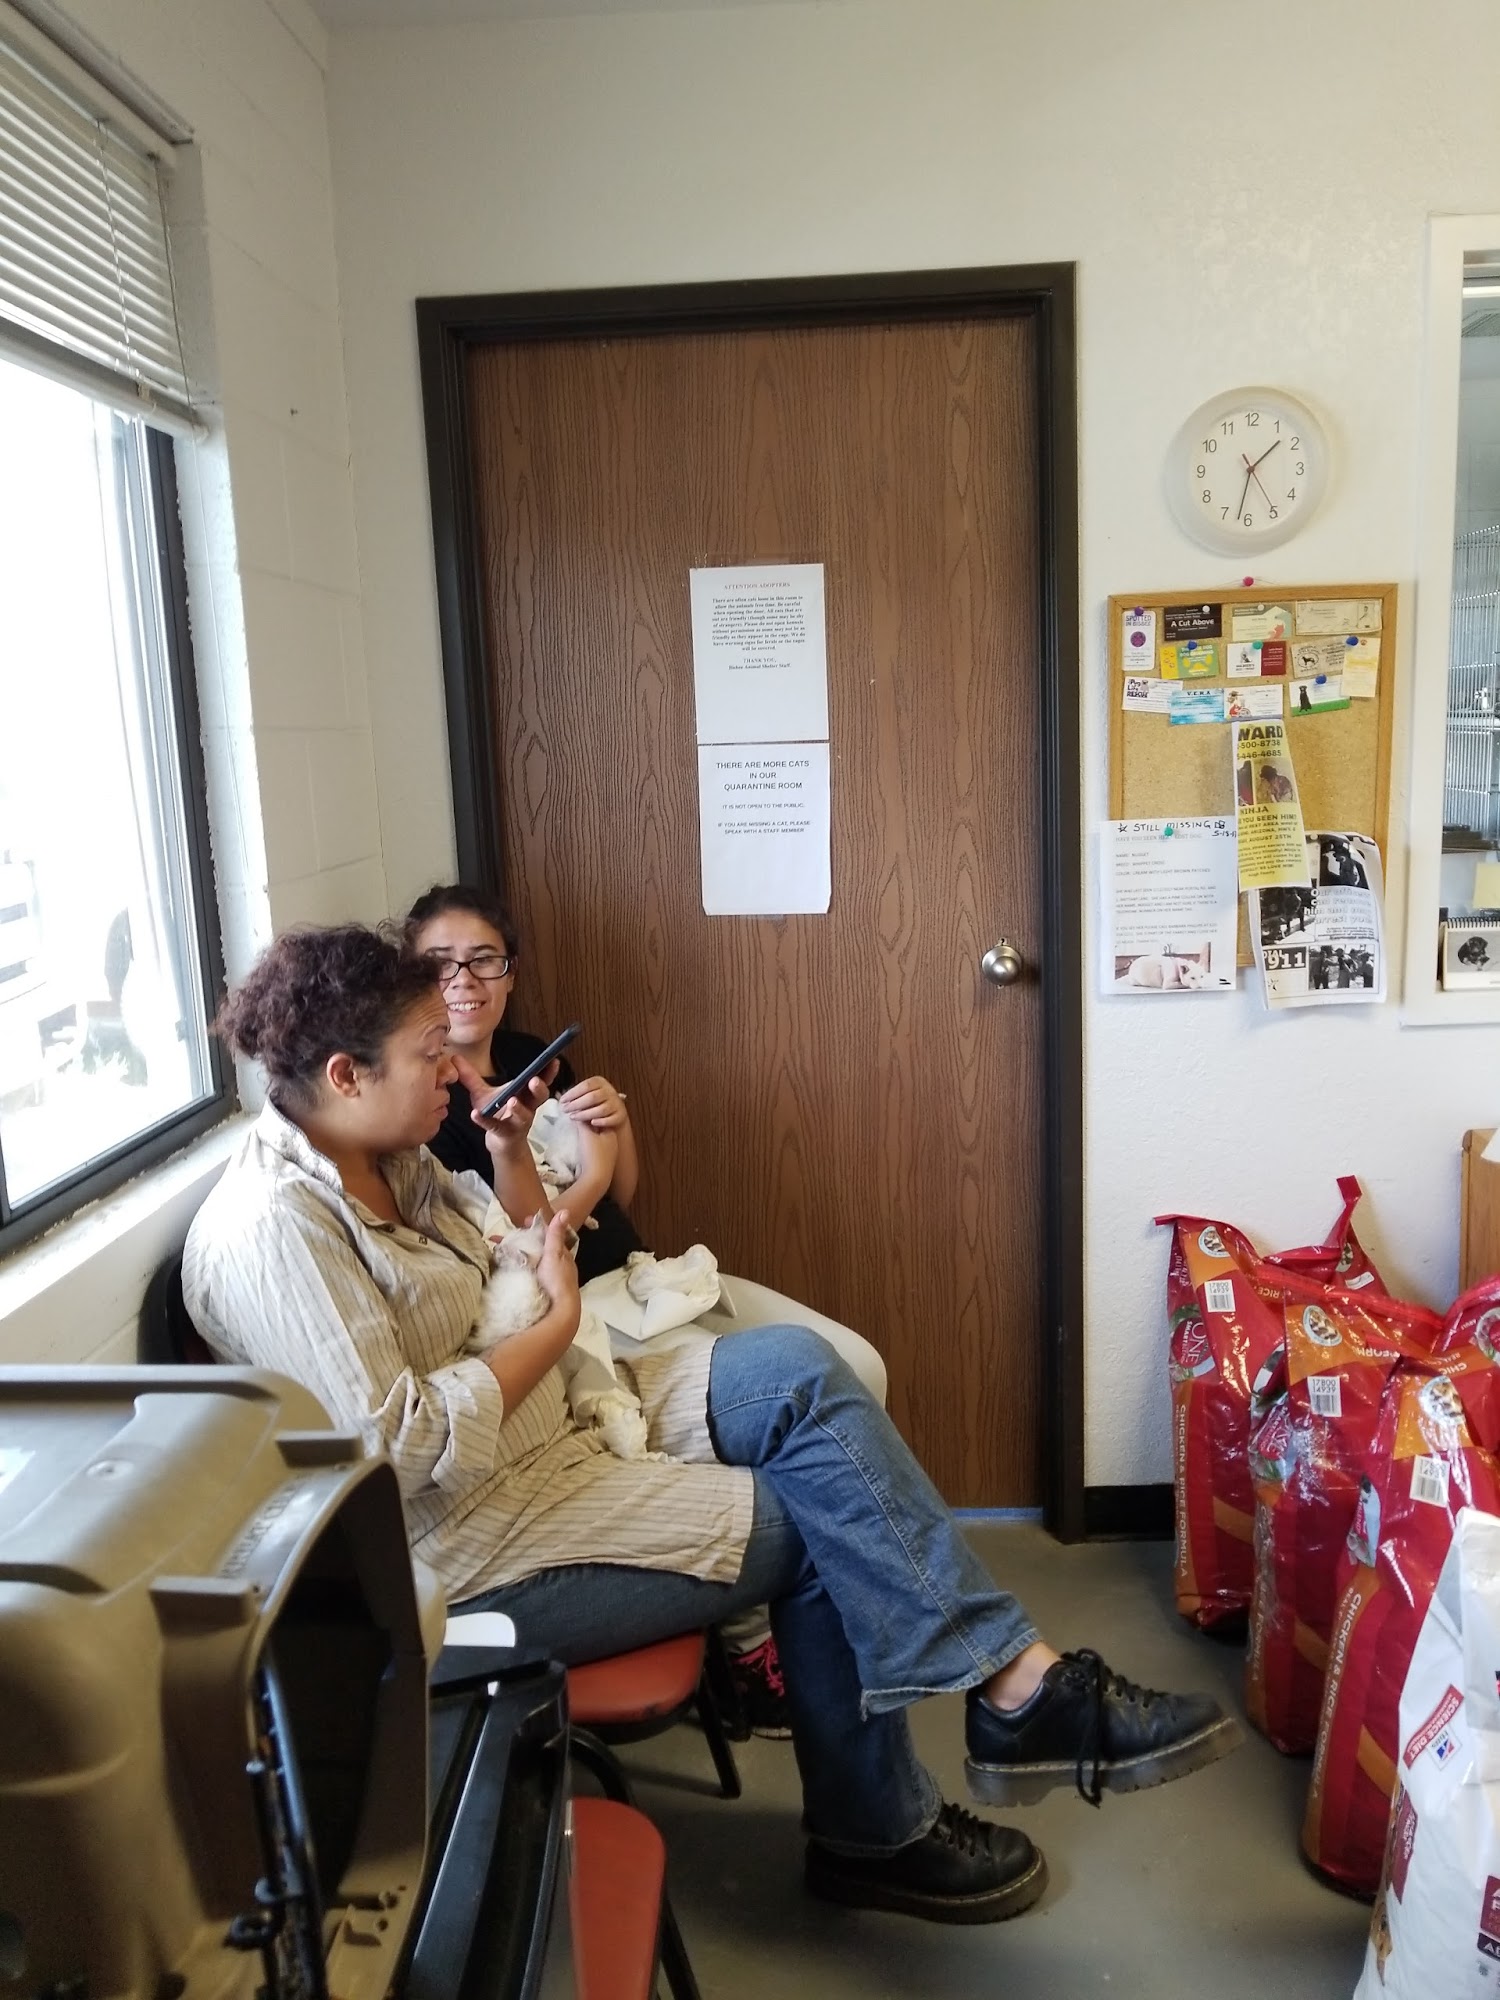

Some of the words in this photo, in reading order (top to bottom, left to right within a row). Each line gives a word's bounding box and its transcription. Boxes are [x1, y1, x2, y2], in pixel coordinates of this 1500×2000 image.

[1245, 413, 1259, 426] 12
[1221, 422, 1234, 435] 11
[1274, 420, 1280, 433] 1
[1202, 439, 1217, 453] 10
[1290, 437, 1300, 450] 2
[1196, 465, 1205, 478] 9
[1295, 462, 1304, 475] 3
[1202, 490, 1211, 503] 8
[1287, 487, 1296, 500] 4
[1221, 507, 1229, 520] 7
[1269, 506, 1278, 519] 5
[1243, 514, 1252, 526] 6
[1171, 620, 1177, 628] A
[1192, 618, 1215, 626] Above
[788, 760, 810, 768] CATS
[724, 782, 776, 792] QUARANTINE
[1133, 823, 1160, 832] STILL
[1268, 950, 1305, 969] 911
[1258, 1286, 1280, 1299] RICE
[1186, 1322, 1207, 1365] ONE
[1312, 1379, 1336, 1387] 17800
[1312, 1386, 1336, 1394] 14939
[1178, 1404, 1186, 1463] CHICKEN
[1179, 1511, 1189, 1578] FORMULA
[1336, 1593, 1362, 1665] CHICKEN
[1333, 1664, 1341, 1675] &
[1326, 1679, 1338, 1719] RICE
[1427, 1696, 1460, 1739] SCIENCE
[1410, 1735, 1428, 1761] DIET
[1313, 1721, 1330, 1799] FORMULA
